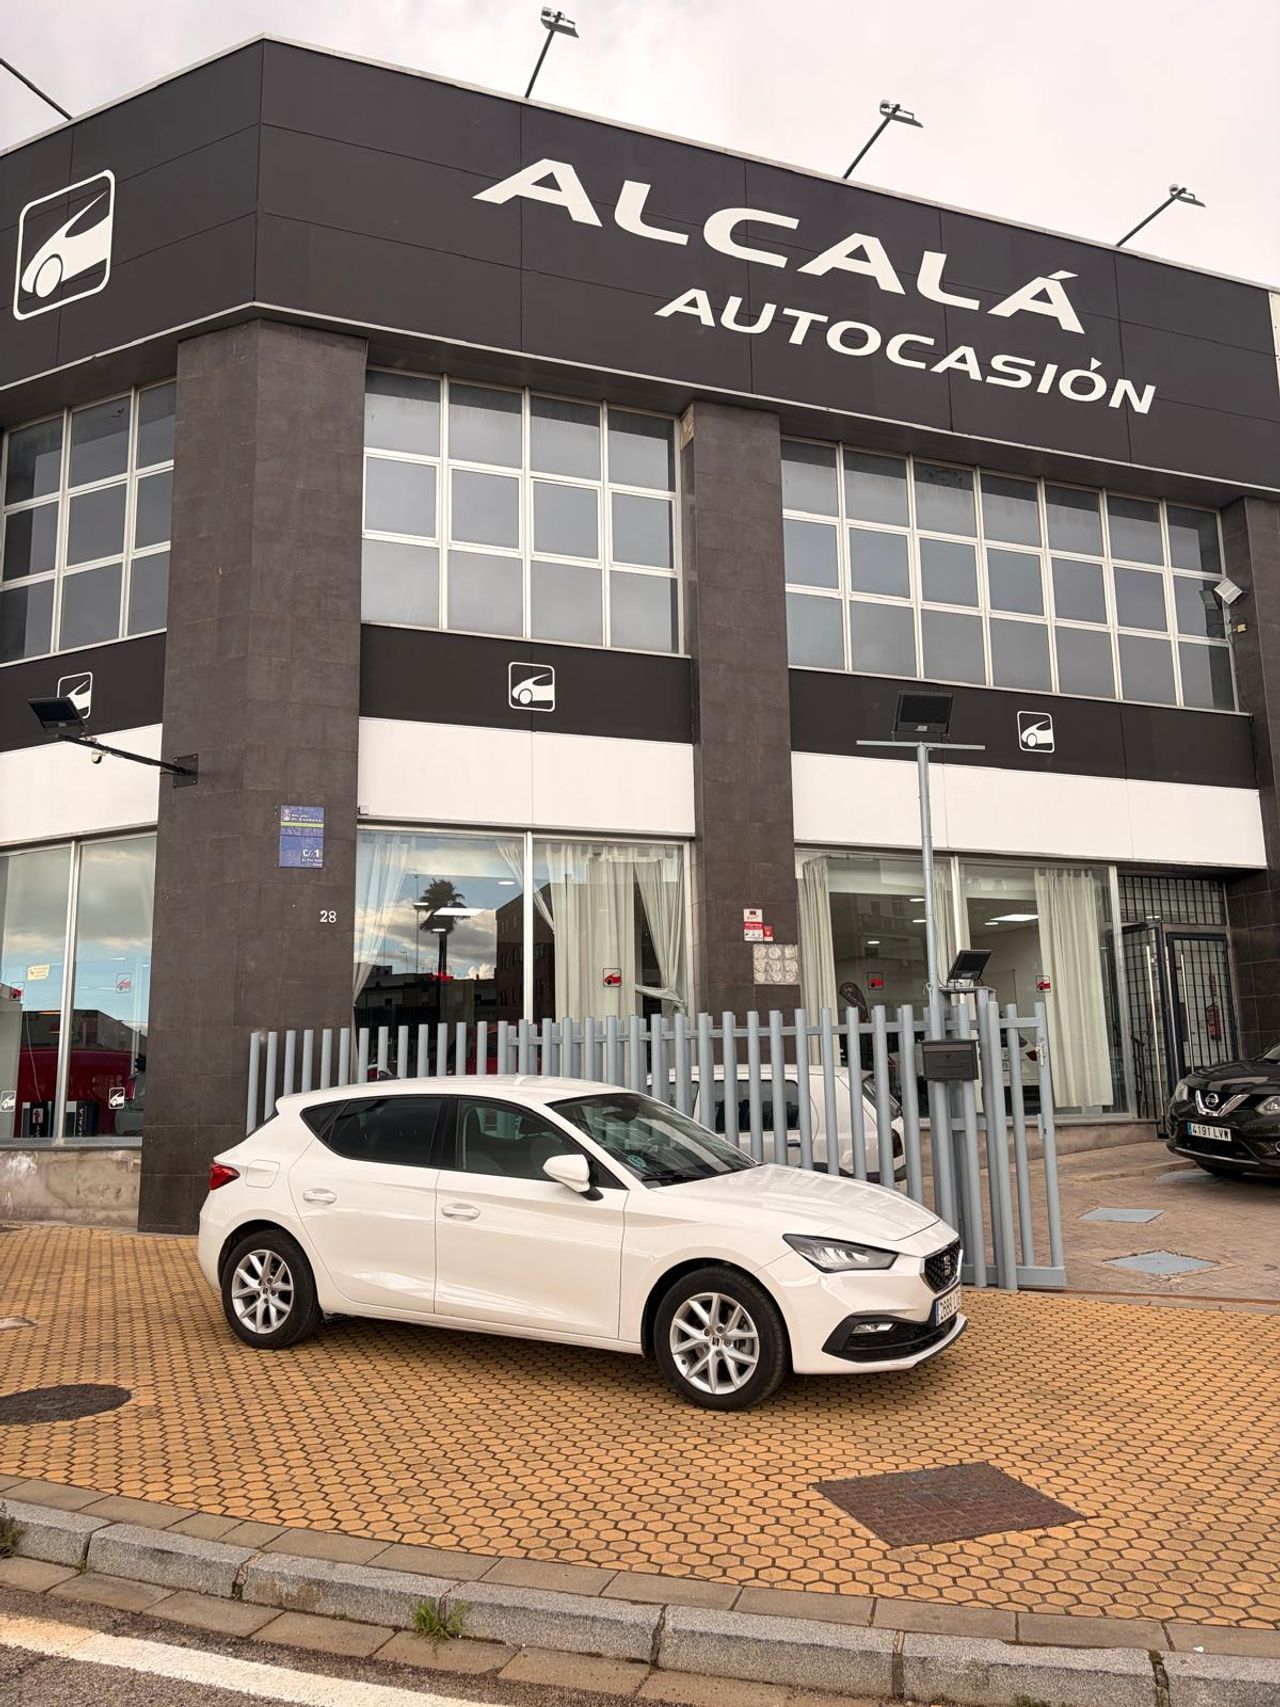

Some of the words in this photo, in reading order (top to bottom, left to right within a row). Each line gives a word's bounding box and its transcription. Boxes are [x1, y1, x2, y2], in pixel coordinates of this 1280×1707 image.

[472, 158, 1086, 335] ALCALÁ
[654, 288, 1158, 415] AUTOCASIÓN
[319, 909, 337, 923] 28
